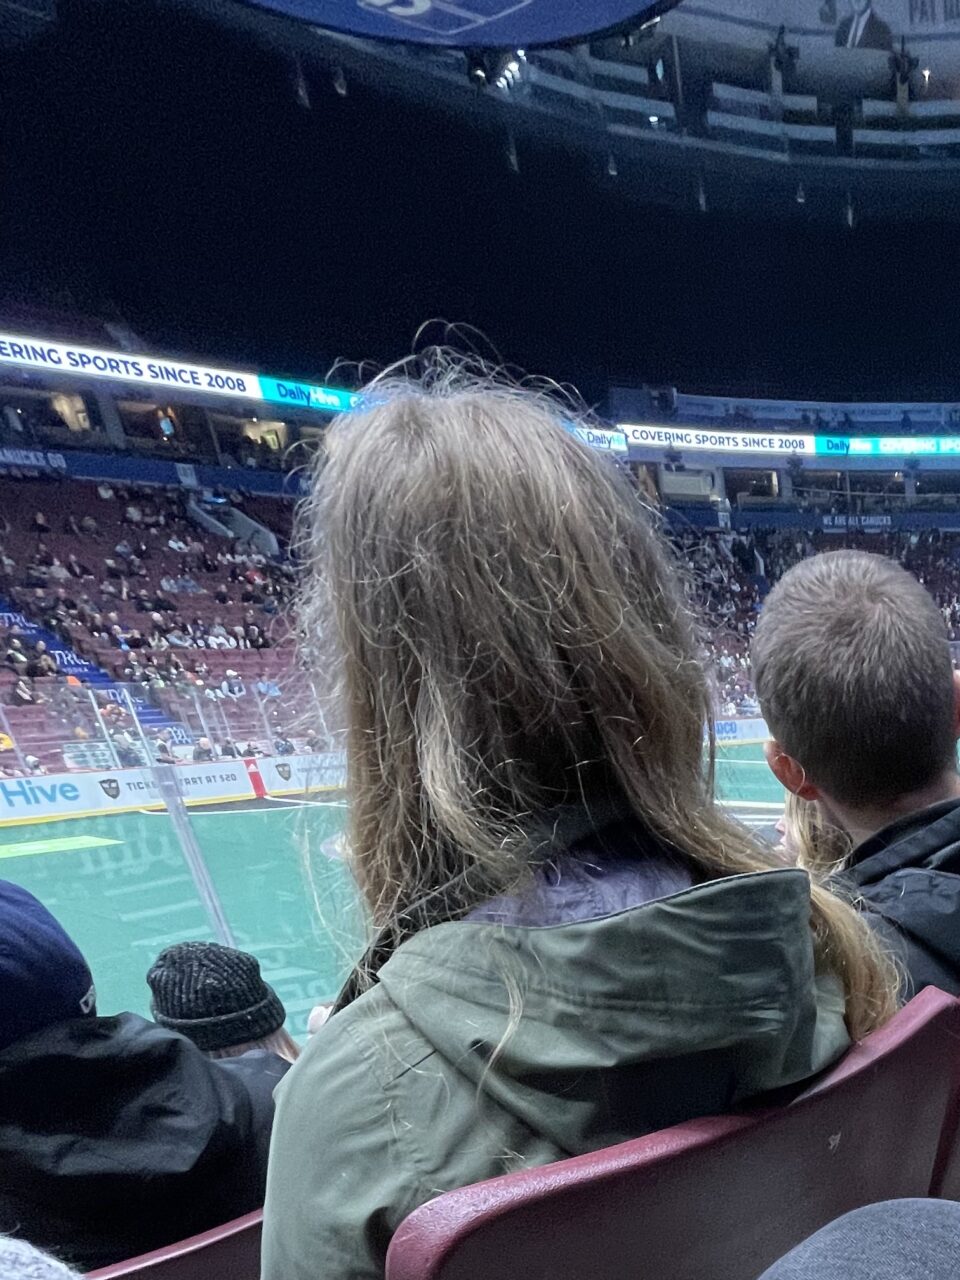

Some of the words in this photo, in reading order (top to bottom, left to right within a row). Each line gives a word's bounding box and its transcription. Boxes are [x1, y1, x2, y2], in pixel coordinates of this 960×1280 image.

[66, 352, 143, 376] SPORTS
[147, 364, 202, 386] SINCE
[206, 373, 247, 392] 2008
[631, 429, 693, 444] COVERING
[695, 434, 739, 447] SPORTS
[742, 437, 775, 449] SINCE
[778, 437, 805, 449] 2008
[0, 779, 81, 808] Hive
